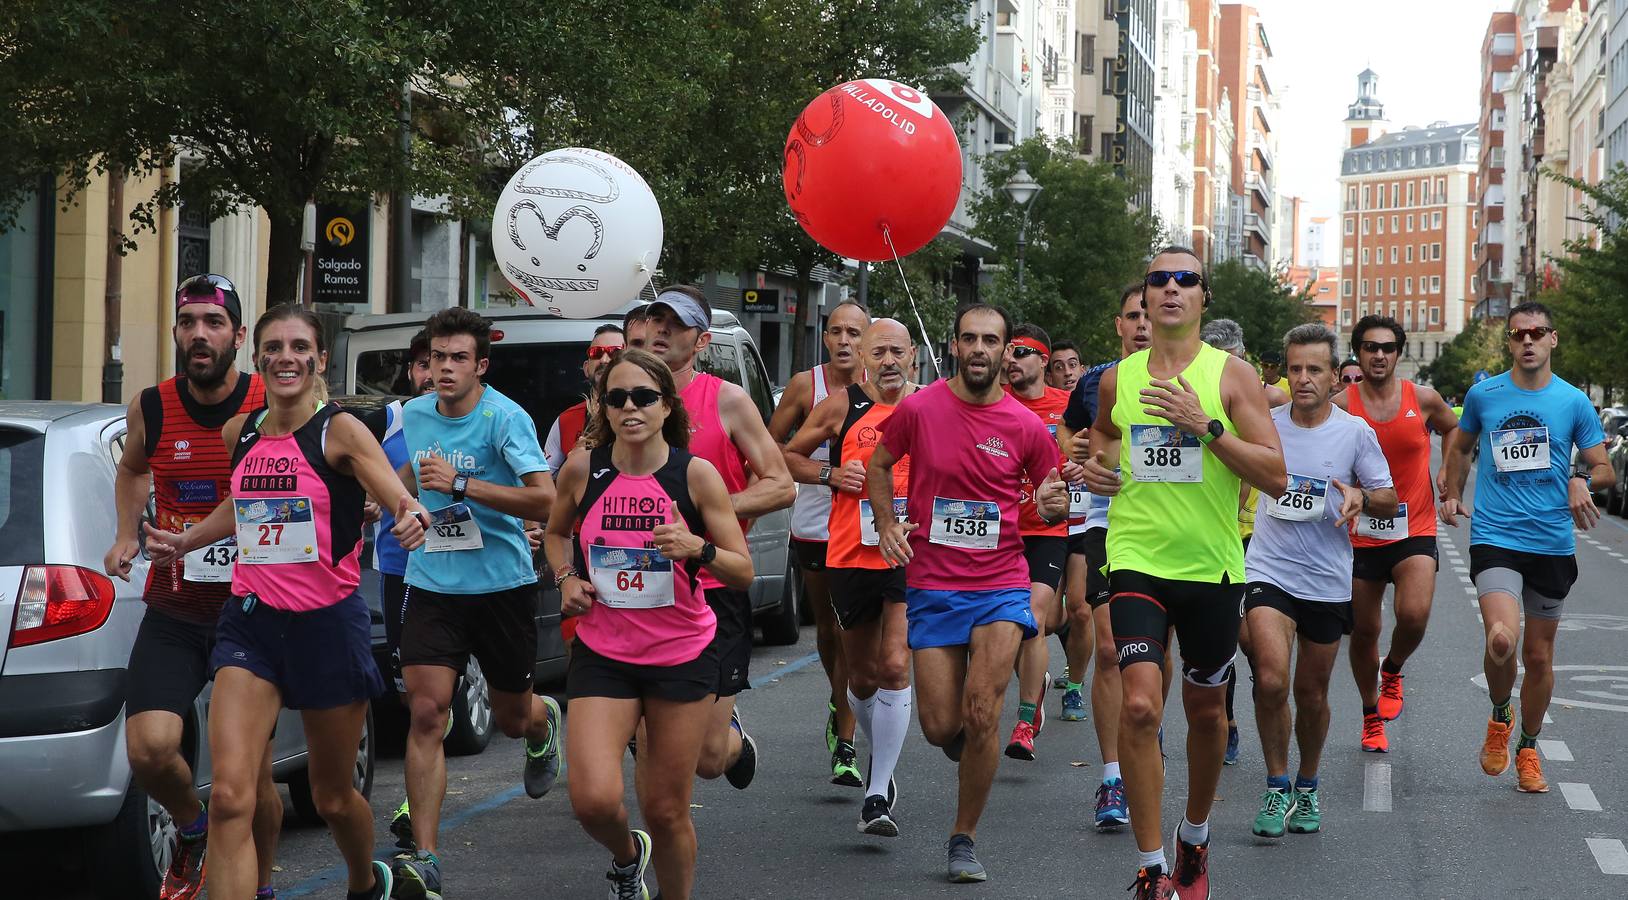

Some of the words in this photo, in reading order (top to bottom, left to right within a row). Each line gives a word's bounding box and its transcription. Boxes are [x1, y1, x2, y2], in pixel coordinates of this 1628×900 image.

[840, 83, 916, 135] VALLADOLID
[566, 148, 651, 193] ALLADOL
[318, 258, 361, 272] Salgado
[324, 273, 359, 284] Ramos
[1143, 447, 1181, 467] 388
[1501, 444, 1539, 460] 1607
[243, 477, 293, 489] RUNNER
[433, 524, 466, 538] 822
[605, 516, 661, 529] RUNNER
[943, 517, 988, 537] 1538
[1369, 518, 1395, 531] 364
[258, 524, 284, 546] 27
[203, 546, 239, 567] 434
[616, 571, 645, 592] 64
